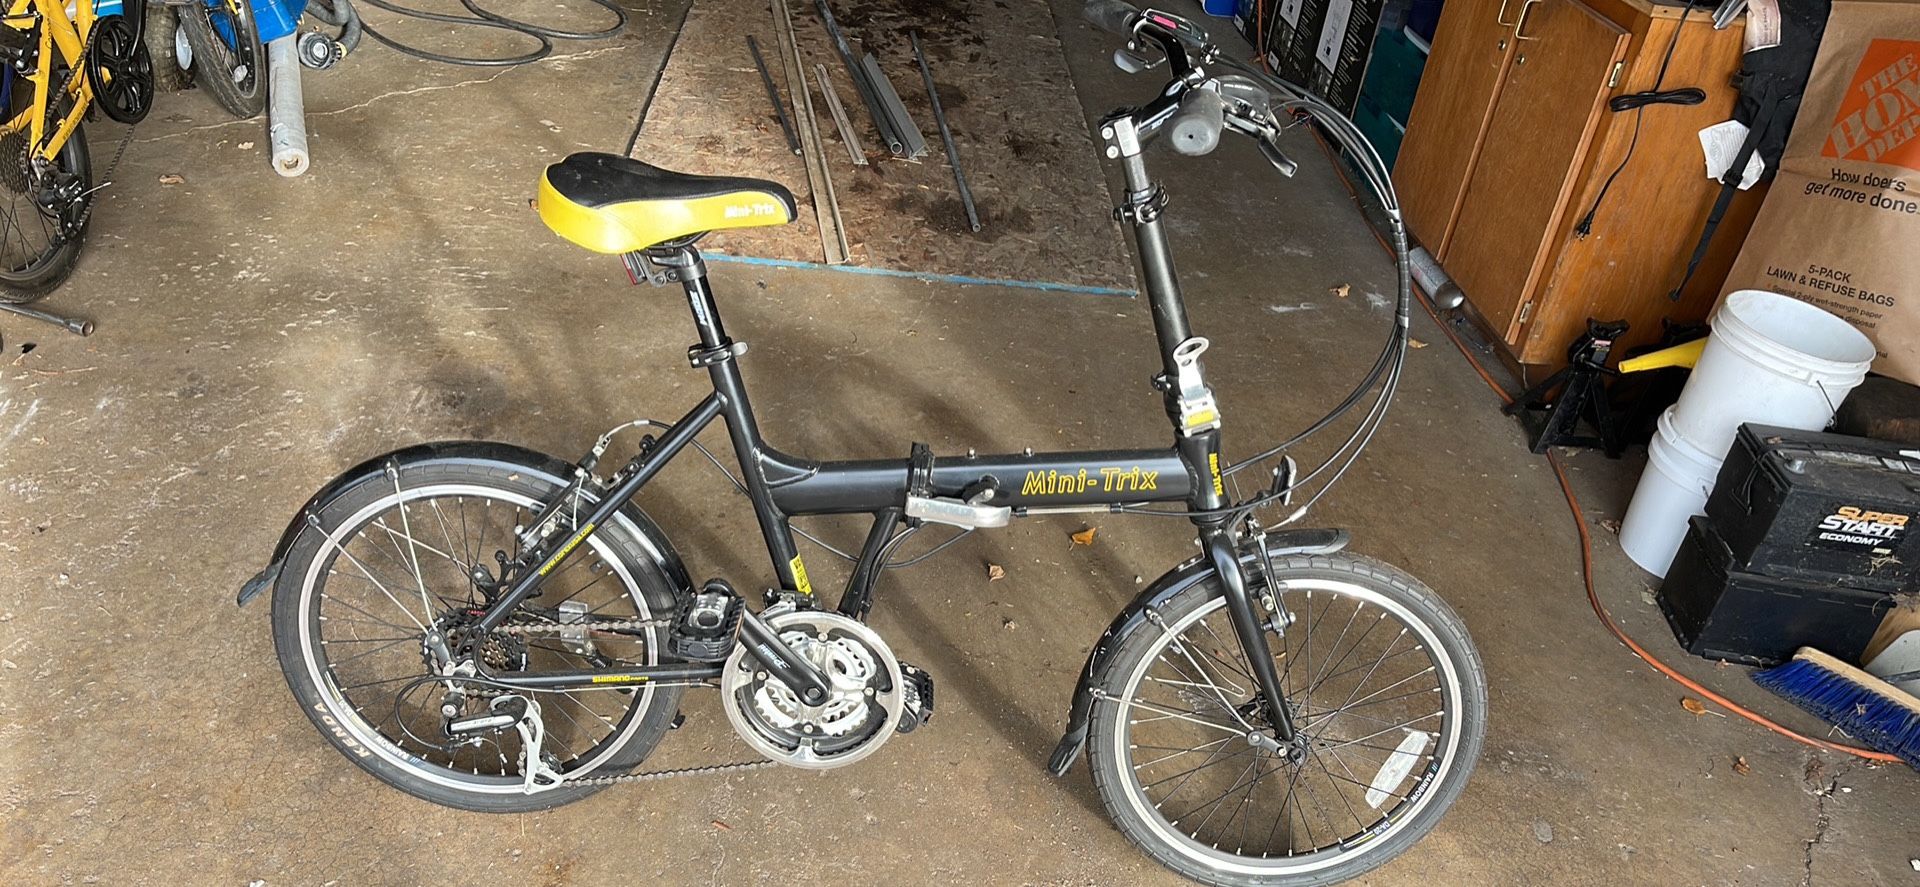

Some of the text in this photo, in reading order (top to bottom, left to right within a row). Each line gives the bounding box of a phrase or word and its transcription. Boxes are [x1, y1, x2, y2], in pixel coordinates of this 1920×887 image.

[1860, 53, 1918, 99] THE
[1831, 68, 1920, 159] HOM
[1865, 113, 1920, 161] DEP
[1804, 181, 1829, 195] get
[1829, 186, 1866, 203] more
[1831, 168, 1906, 192] How doers
[725, 203, 775, 219] Mini-Trix
[1767, 266, 1895, 307] LAWN & REFUSE BAGS
[1808, 264, 1851, 283] 5-PACK
[1021, 465, 1158, 495] Mini-Trix
[1209, 453, 1223, 496] Mini-Trix
[1818, 515, 1905, 538] START
[1838, 506, 1909, 526] SUPER
[1818, 532, 1883, 546] ECONOMY
[314, 702, 371, 757] KENDA
[1410, 771, 1434, 803] RAINBOW
